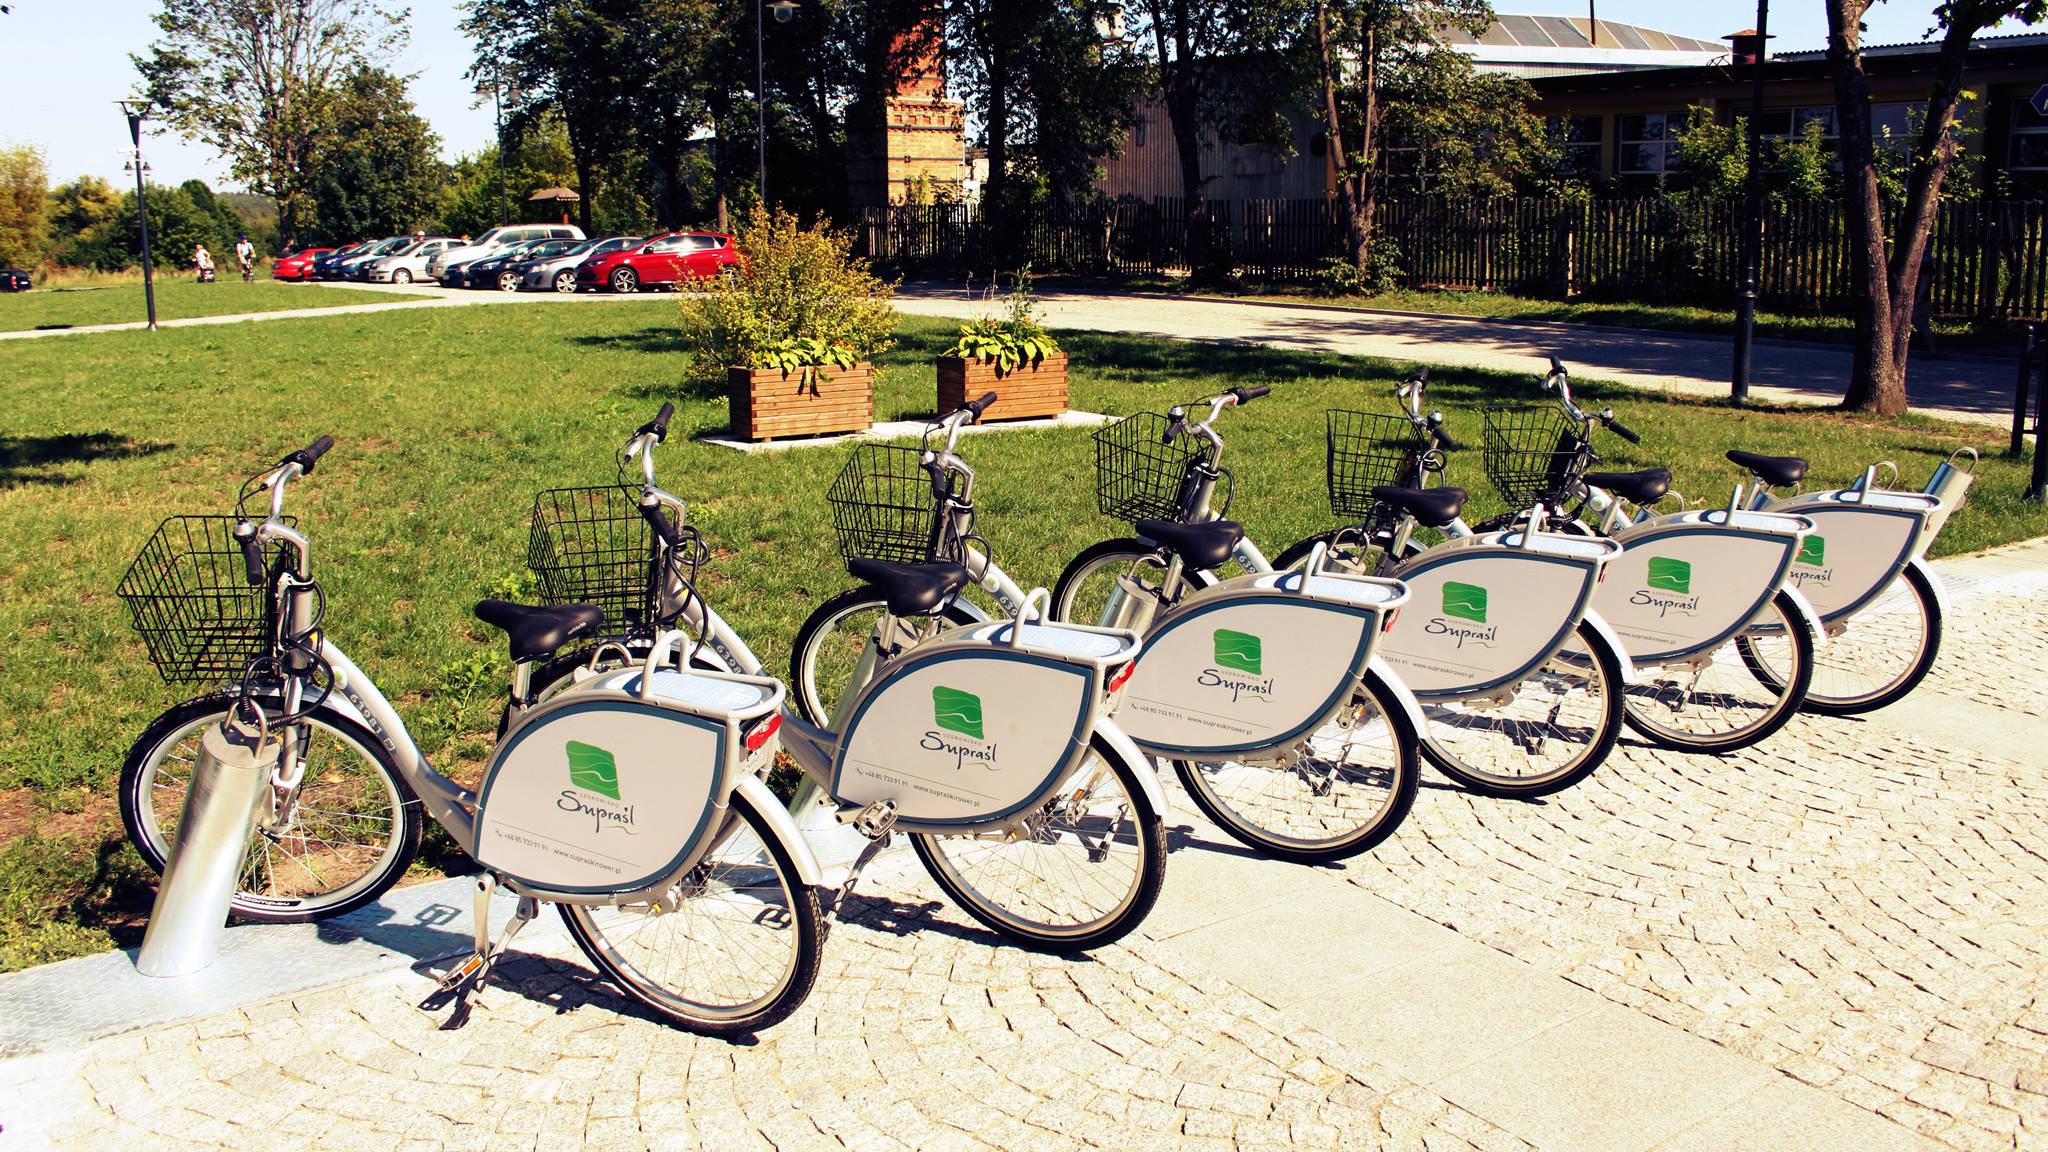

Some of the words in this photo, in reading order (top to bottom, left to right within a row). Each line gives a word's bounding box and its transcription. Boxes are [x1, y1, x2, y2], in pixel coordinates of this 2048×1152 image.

[350, 693, 383, 734] 63981
[1187, 716, 1253, 735] www.supraskirower.pl
[913, 784, 980, 807] www.supraskirower.pl
[553, 848, 622, 874] www.supraskirower.pl
